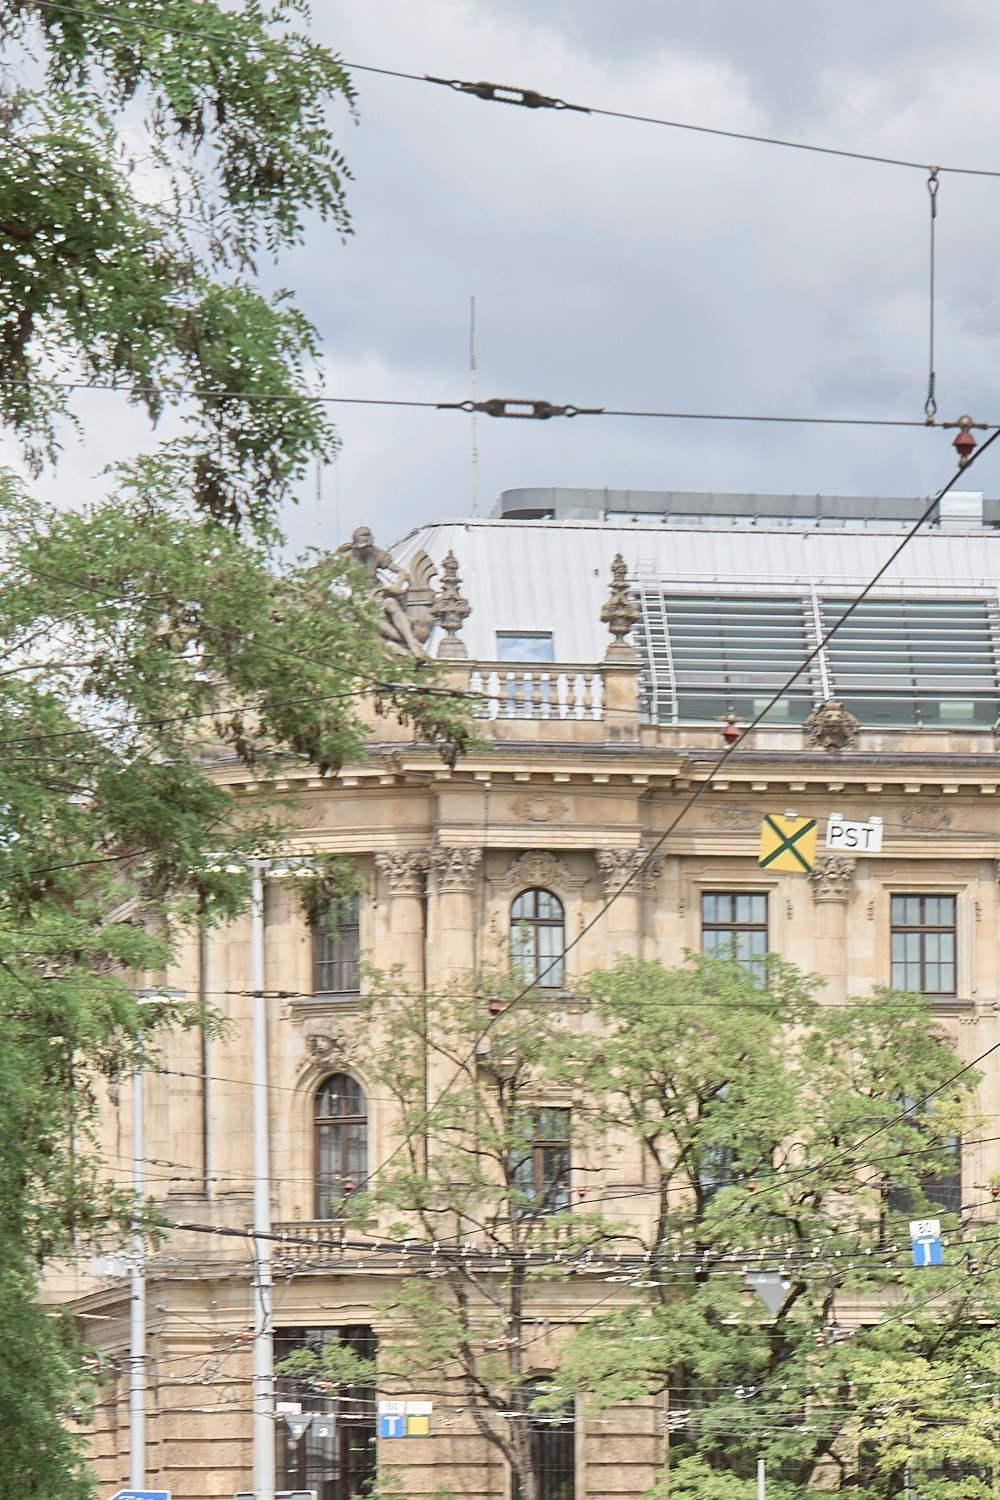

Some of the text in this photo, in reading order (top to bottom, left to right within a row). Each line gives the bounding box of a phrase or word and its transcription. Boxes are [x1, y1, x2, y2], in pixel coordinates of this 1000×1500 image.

[829, 826, 874, 848] PST
[917, 1222, 933, 1233] 80
[318, 1427, 329, 1437] 3
